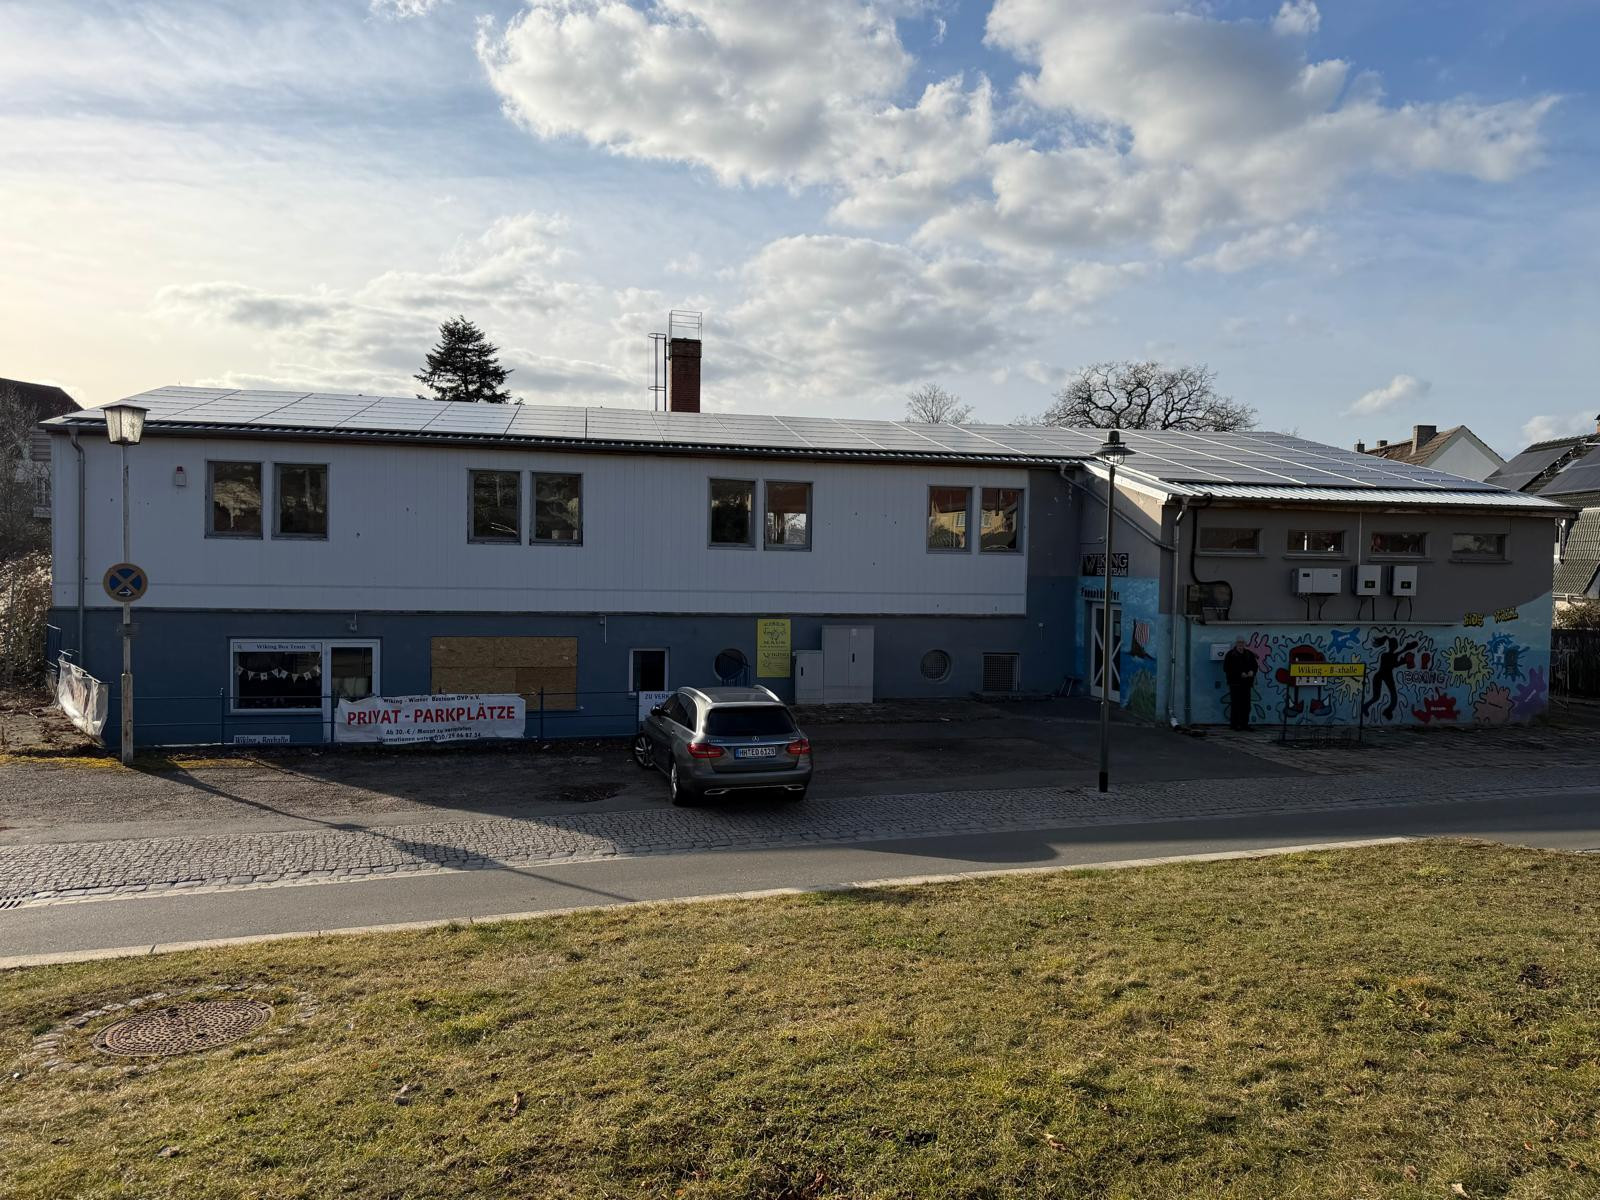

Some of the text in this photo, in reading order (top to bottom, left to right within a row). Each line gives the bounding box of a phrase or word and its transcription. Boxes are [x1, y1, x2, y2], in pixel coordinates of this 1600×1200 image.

[1298, 665, 1321, 676] Wiking
[1329, 665, 1358, 674] Bxhalle
[1404, 671, 1445, 684] BOXING
[347, 709, 401, 725] PRIVAT
[414, 702, 515, 723] PARKPLÄTZE
